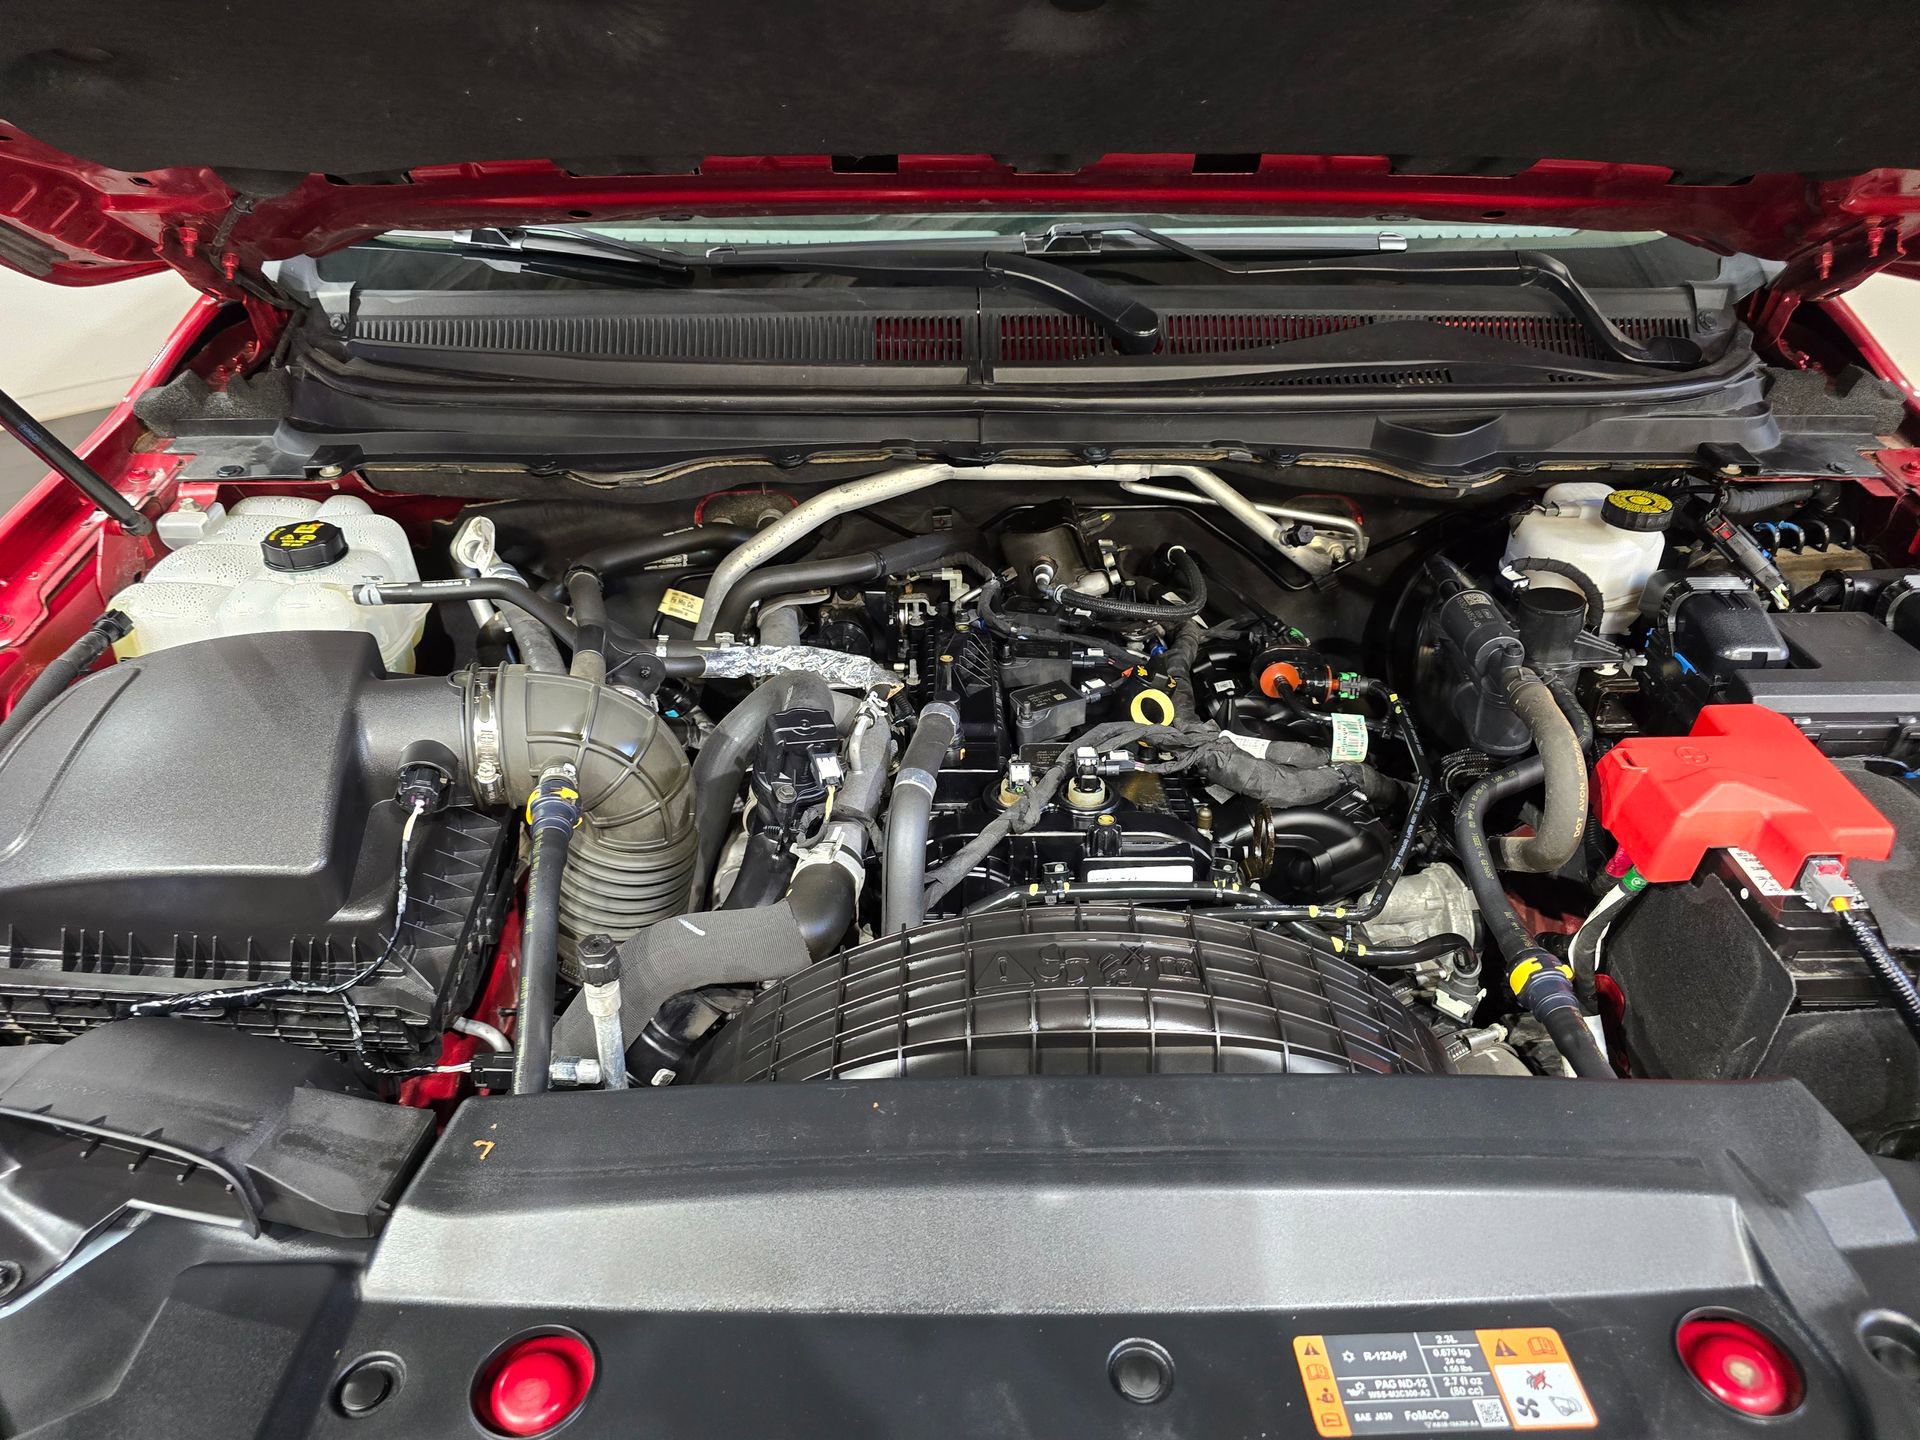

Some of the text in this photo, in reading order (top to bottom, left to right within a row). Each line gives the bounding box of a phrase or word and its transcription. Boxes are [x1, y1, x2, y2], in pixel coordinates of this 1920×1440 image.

[1573, 817, 1583, 838] DOT
[1435, 1334, 1458, 1344] 2.3L
[1432, 1347, 1471, 1358] 0.675 kg
[1374, 1378, 1428, 1390] PAG ND-12
[1443, 1376, 1483, 1387] 2.7 fl oz
[1450, 1385, 1484, 1396] (80 cc)
[1354, 1412, 1372, 1422] SAE
[1404, 1409, 1450, 1421] FoMoCo
